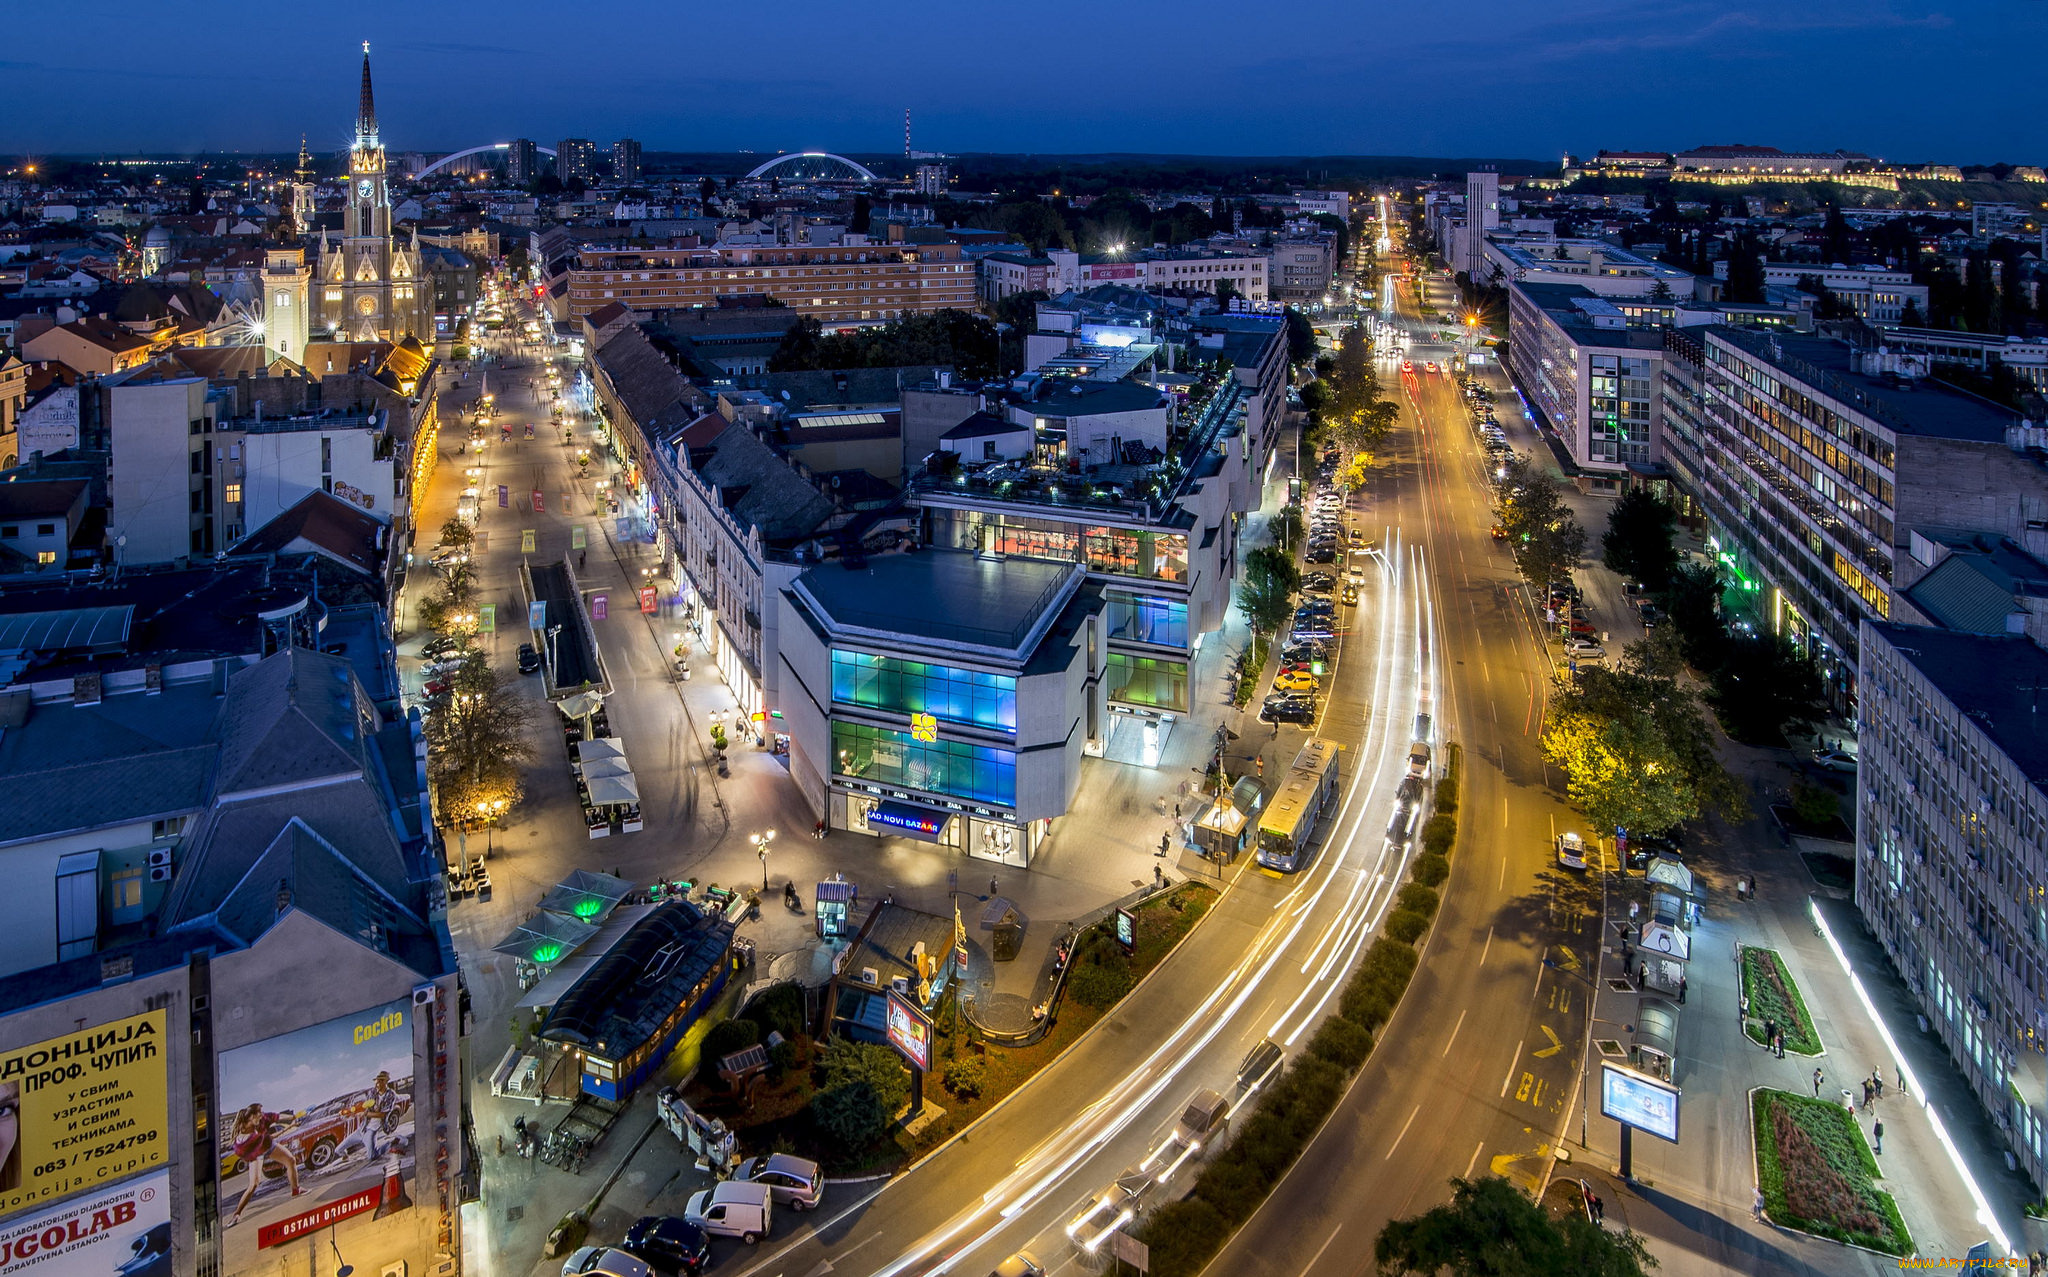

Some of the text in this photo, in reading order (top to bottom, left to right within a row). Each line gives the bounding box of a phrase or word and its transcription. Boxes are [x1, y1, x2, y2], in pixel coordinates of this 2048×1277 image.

[866, 786, 881, 795] ZARA
[893, 791, 908, 800] ZARA
[946, 802, 962, 811] ZARA
[884, 815, 904, 825] NOVI
[905, 820, 938, 832] BAZAAR
[353, 1011, 402, 1045] Cockta
[0, 1021, 156, 1080] ДОНЦИЈА
[25, 1041, 157, 1094] ПРОФ. ЧУПИЋ
[80, 1080, 119, 1098] СВИМ
[53, 1090, 134, 1121] УЗРАСТИМА
[68, 1108, 121, 1131] И СВИМ
[52, 1118, 136, 1150] ТЕХНИКАМА
[33, 1159, 67, 1177] 063
[83, 1130, 158, 1162] 7524799
[1, 1190, 135, 1242] ZA LABORATORIJSKU DIJAGNOSTIKU
[324, 1195, 371, 1220] ORIGINAL
[2, 1232, 110, 1275] ZDRAVSTVENA USTANOVA
